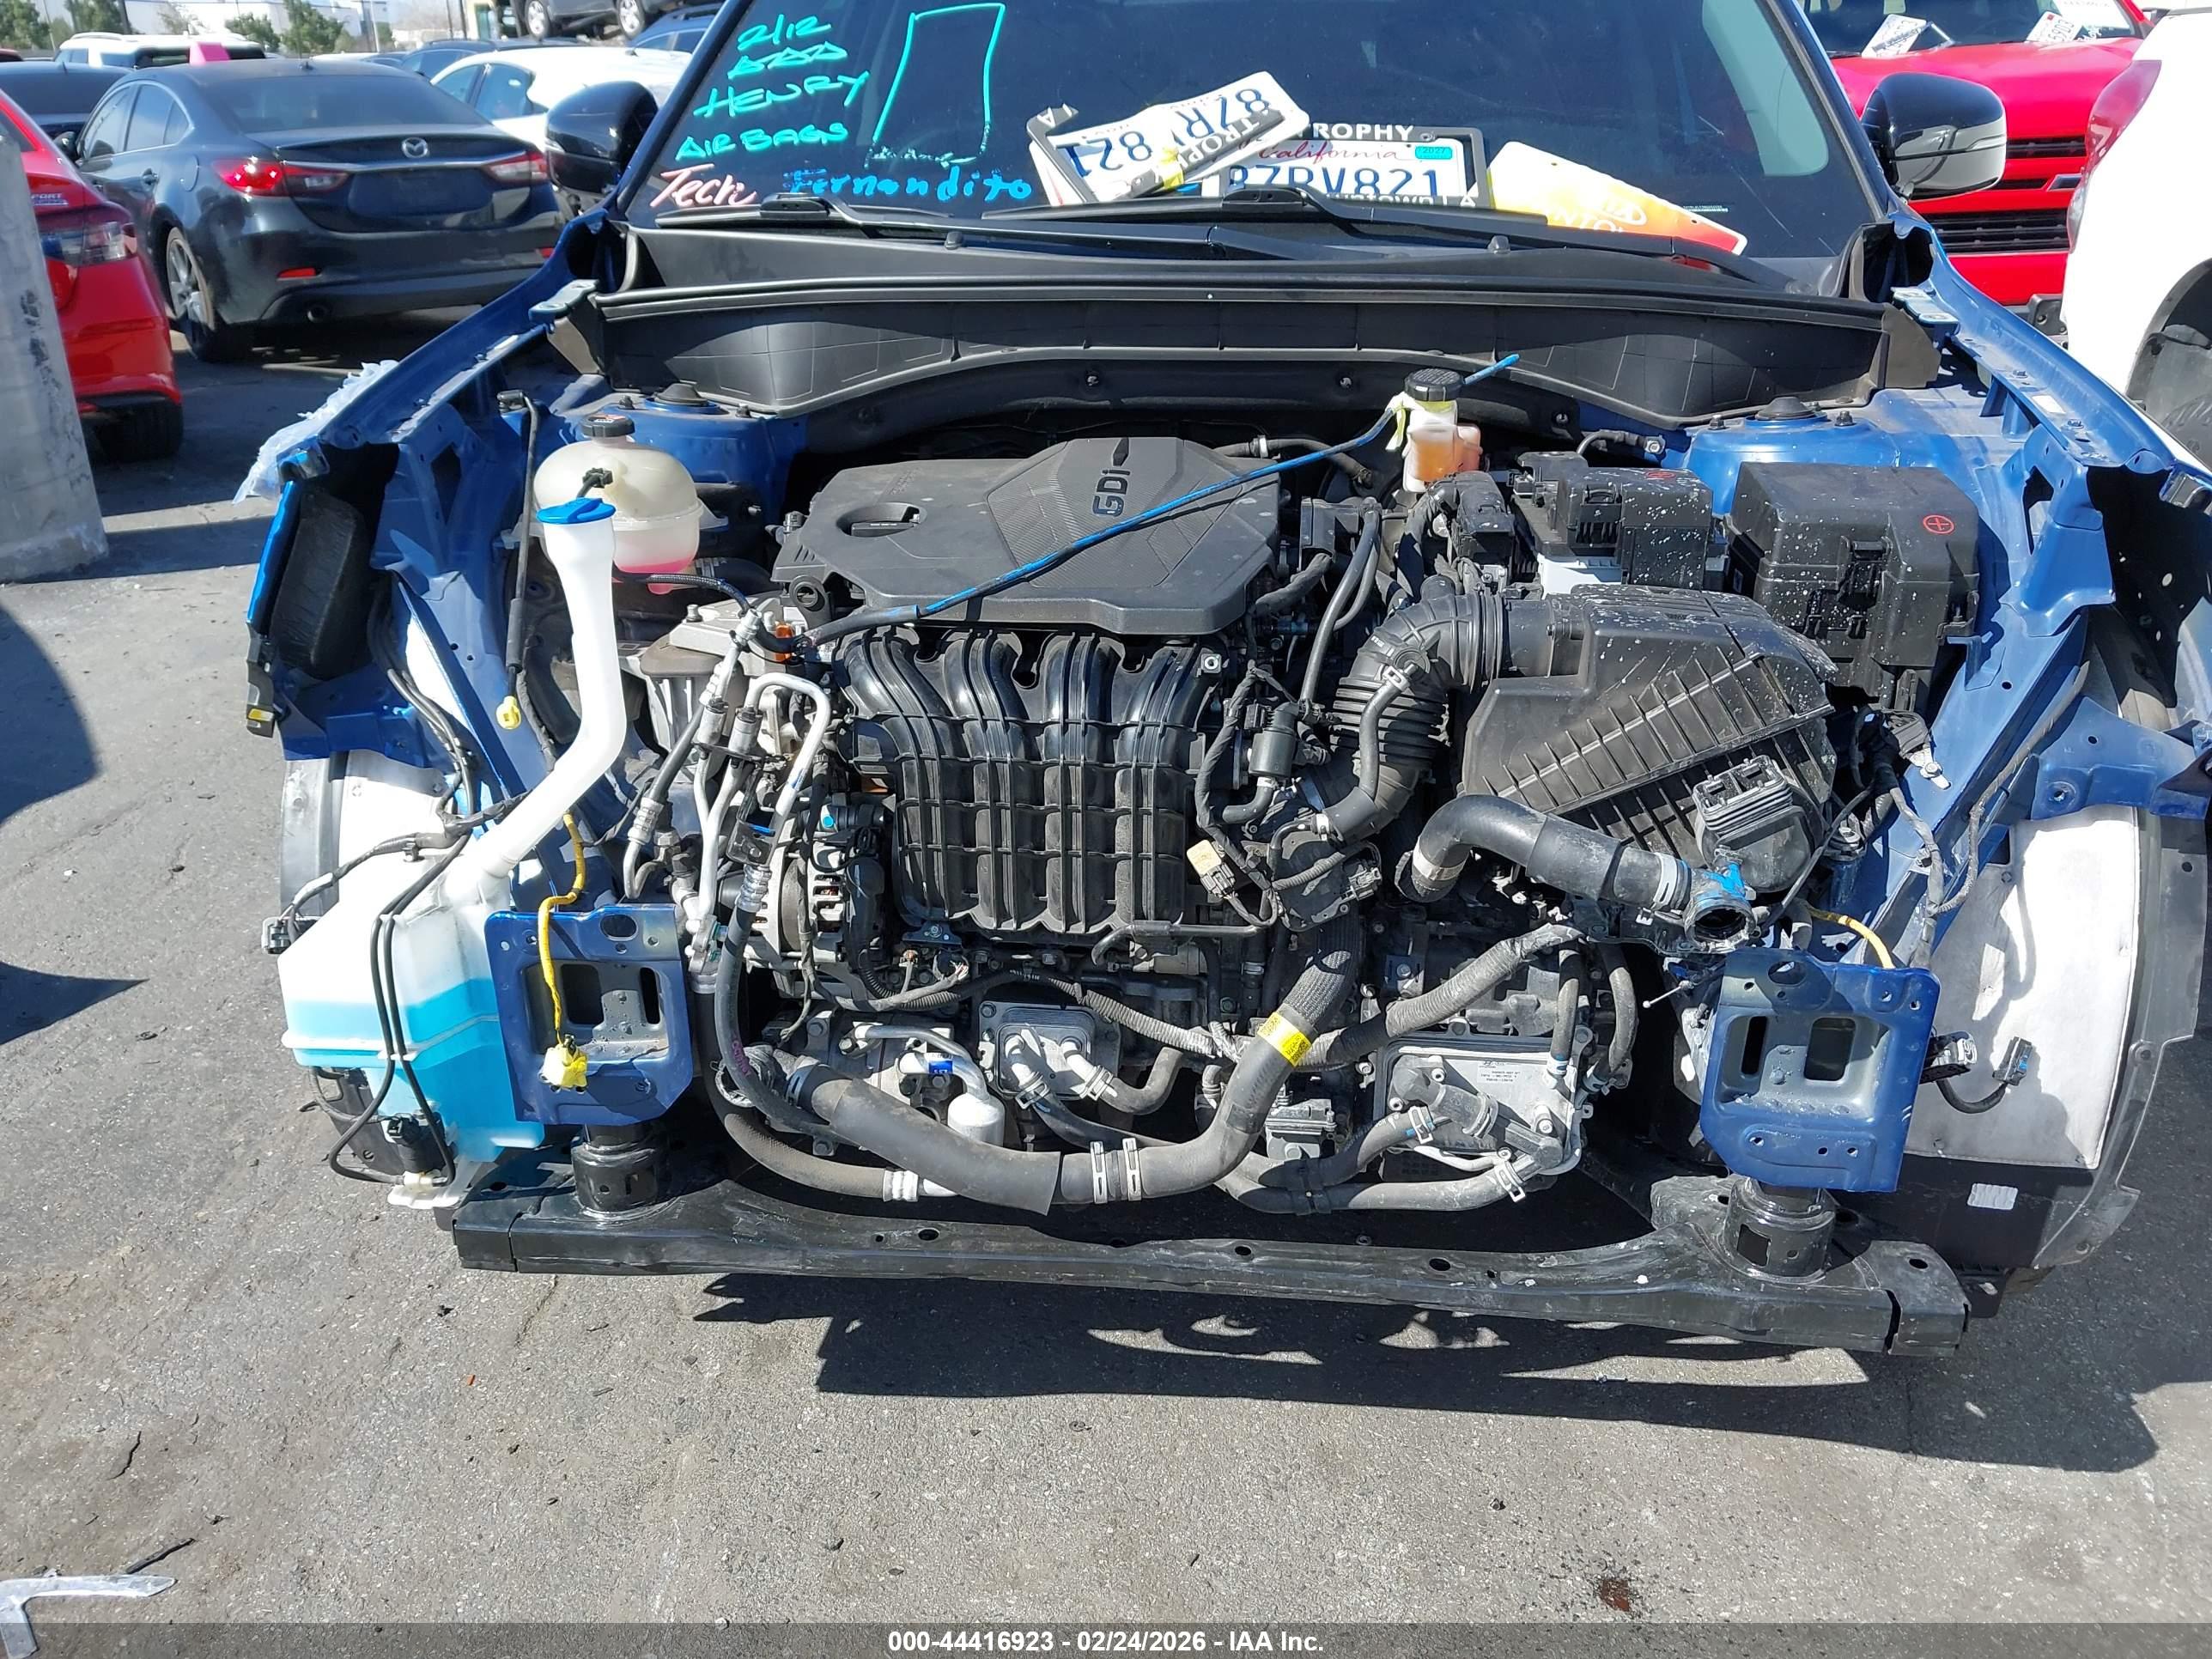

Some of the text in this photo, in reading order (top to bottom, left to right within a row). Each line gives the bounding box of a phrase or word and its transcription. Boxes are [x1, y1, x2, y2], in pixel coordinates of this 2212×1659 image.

[693, 70, 870, 118] HENRY
[1258, 140, 1397, 163] California
[650, 163, 757, 207] Tech
